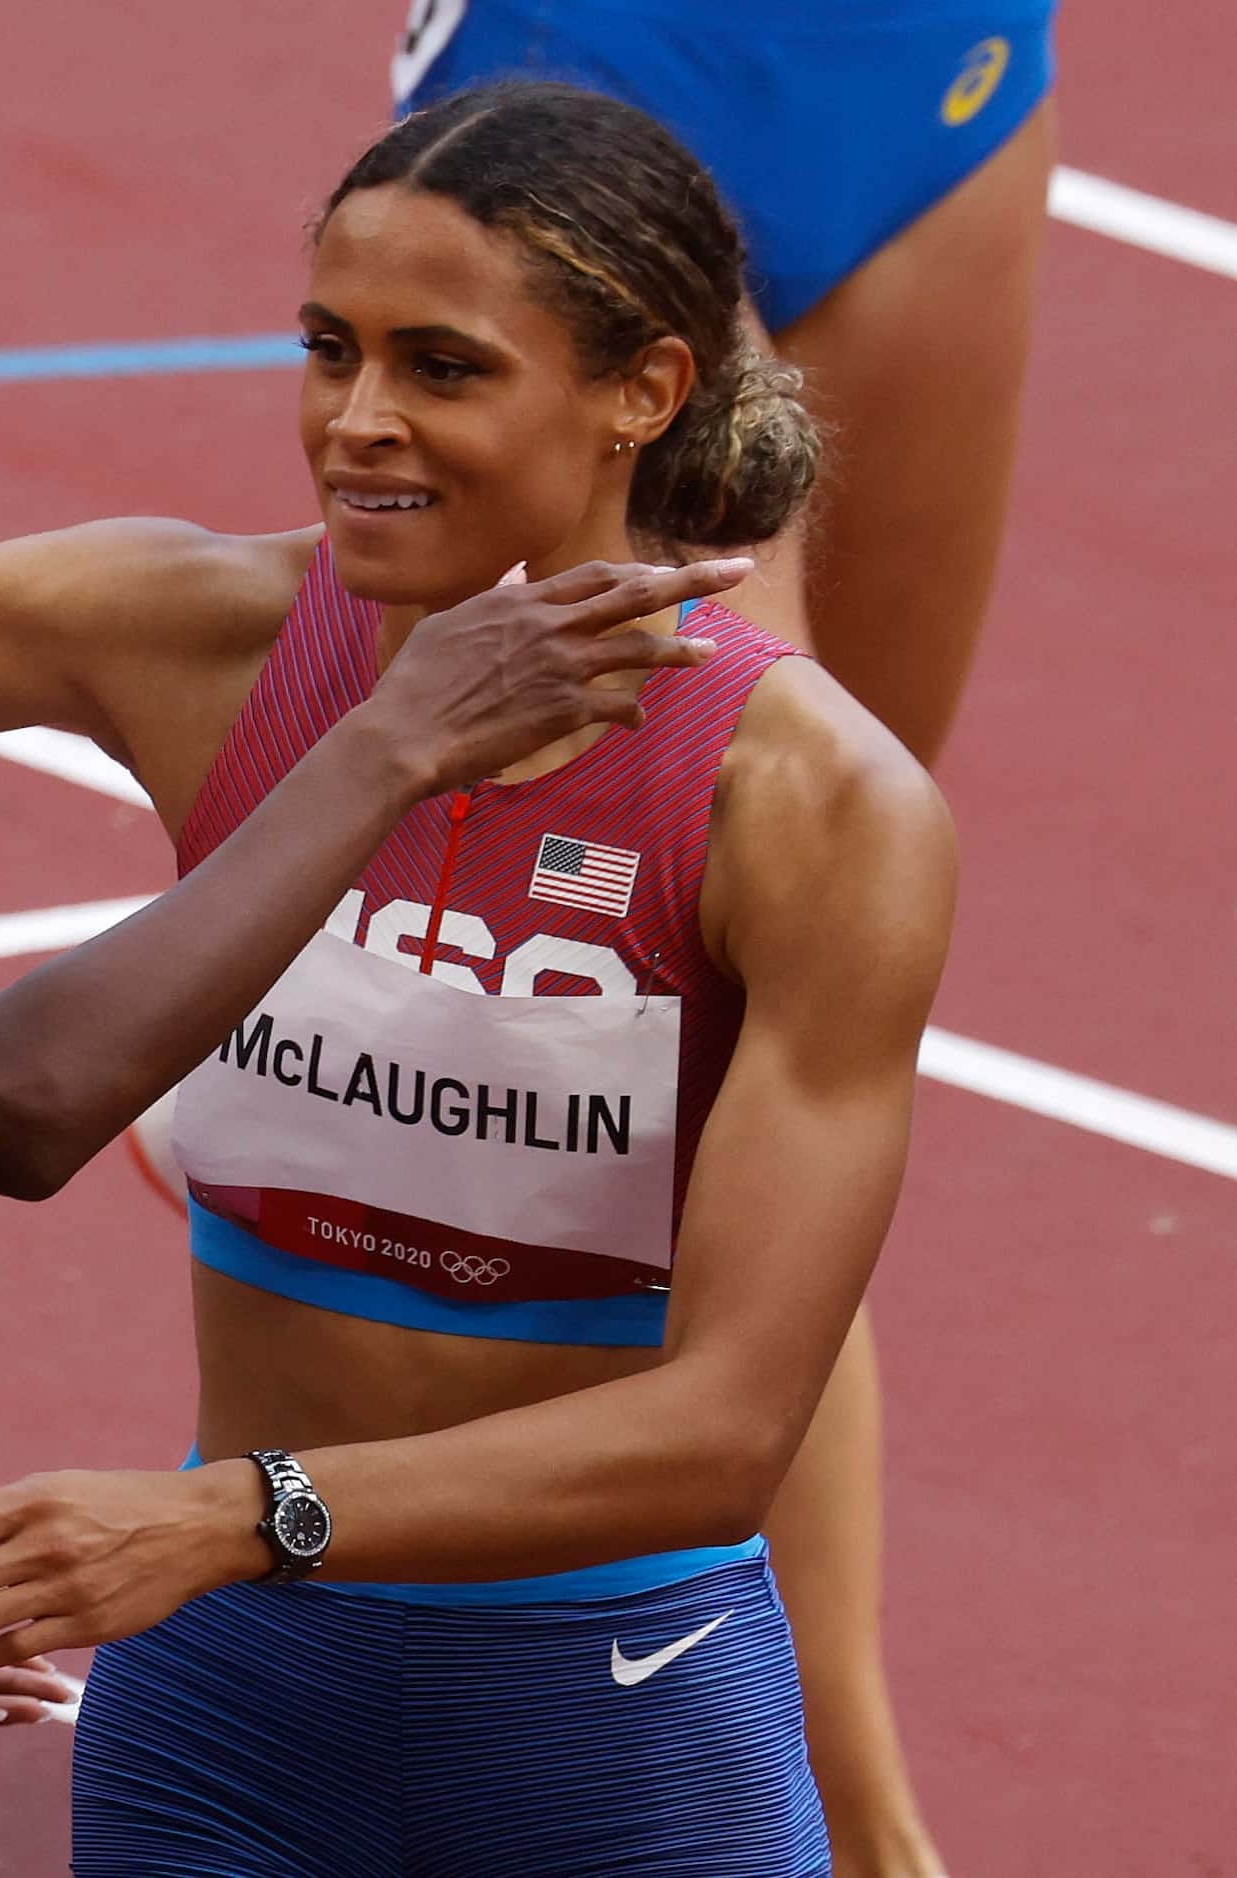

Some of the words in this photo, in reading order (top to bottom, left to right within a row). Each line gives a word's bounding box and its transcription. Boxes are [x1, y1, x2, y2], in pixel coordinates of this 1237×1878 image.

[219, 1013, 632, 1155] McLAUGHLIN
[307, 1217, 377, 1253] TOKYO
[380, 1238, 433, 1270] 2020
